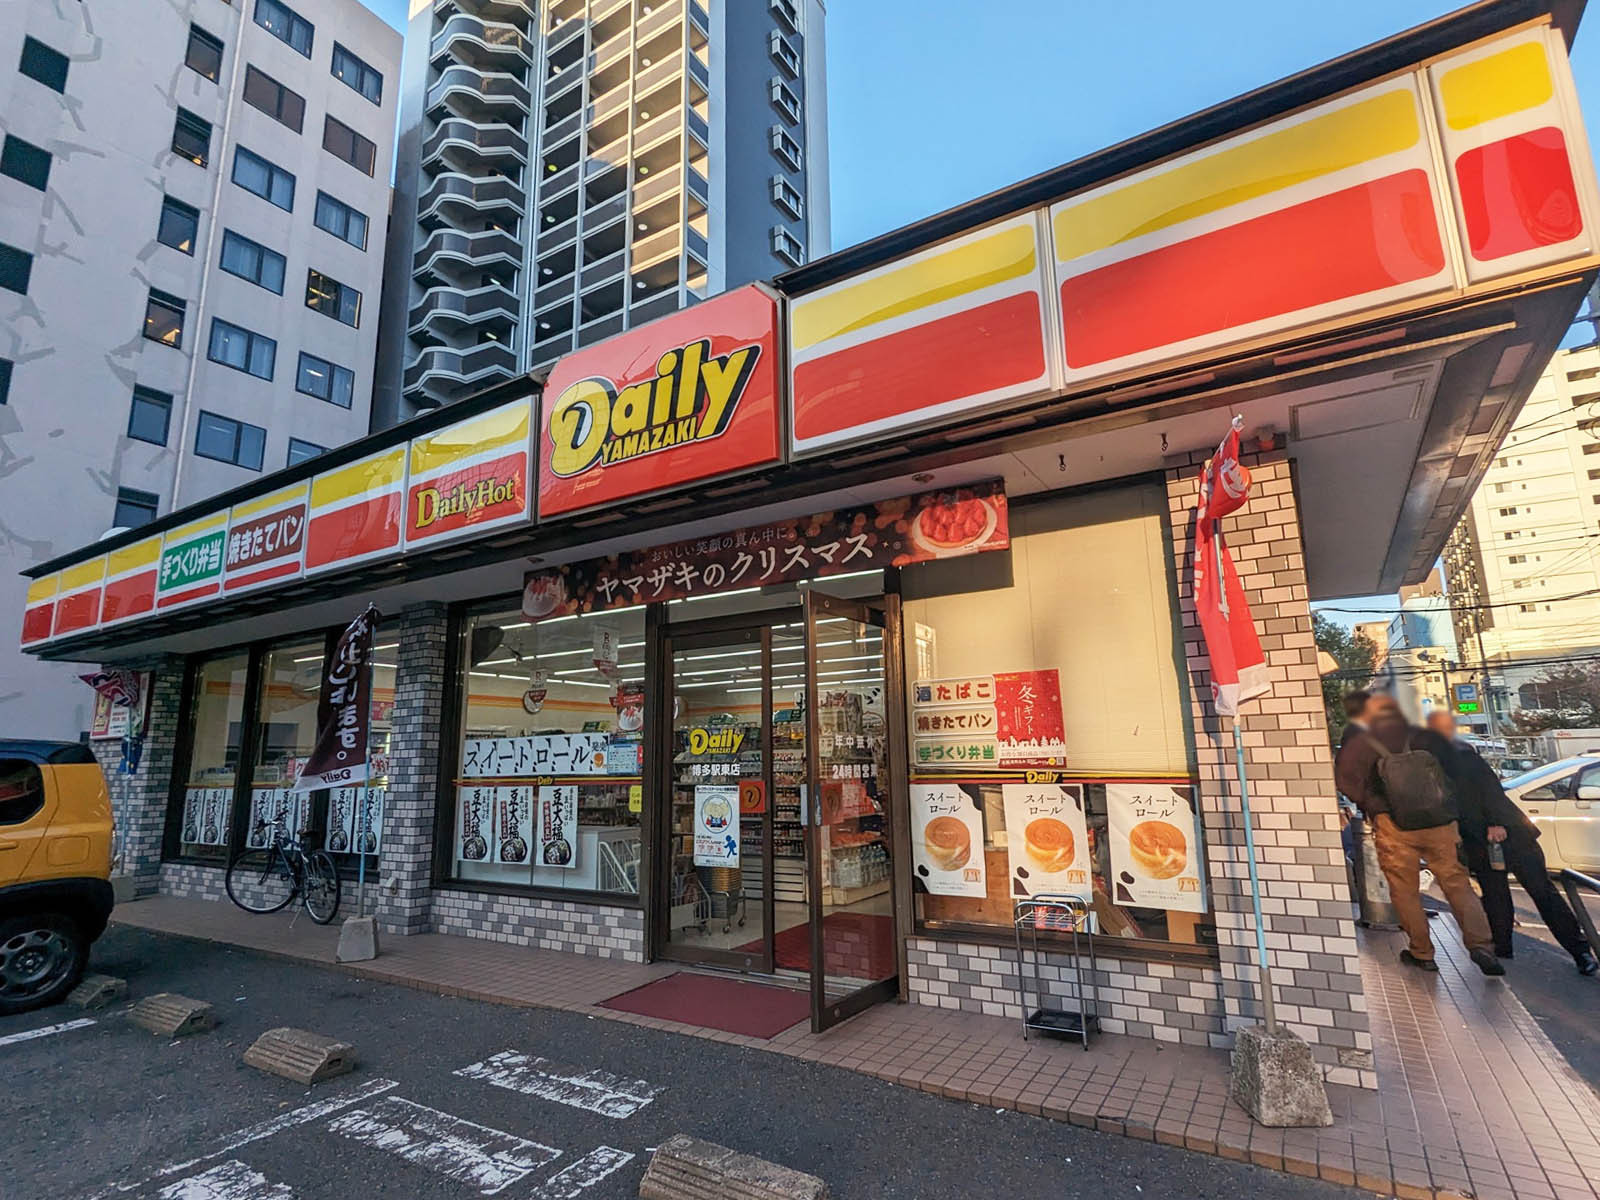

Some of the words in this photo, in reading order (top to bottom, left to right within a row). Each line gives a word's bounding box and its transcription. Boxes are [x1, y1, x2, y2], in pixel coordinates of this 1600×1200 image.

[549, 338, 761, 478] Daily
[601, 416, 697, 466] YAMAZAKI
[227, 515, 304, 565] 焼きたてパン
[162, 539, 222, 585] 手づくり弁当
[597, 533, 874, 602] ヤマザキのクリスマス
[936, 682, 990, 700] たばこ
[917, 713, 992, 731] 焼きたてパン
[690, 728, 744, 755] Daily
[464, 745, 590, 769] スイートロール
[692, 763, 740, 776] 博多駅東店
[1026, 770, 1059, 783] Daily
[924, 792, 964, 802] スイート
[1024, 794, 1067, 804] スイート
[1129, 794, 1178, 806] スイート
[552, 788, 564, 841] 豆大福
[930, 804, 961, 813] ロール
[1029, 805, 1064, 815] ロール
[1136, 808, 1175, 818] ロール
